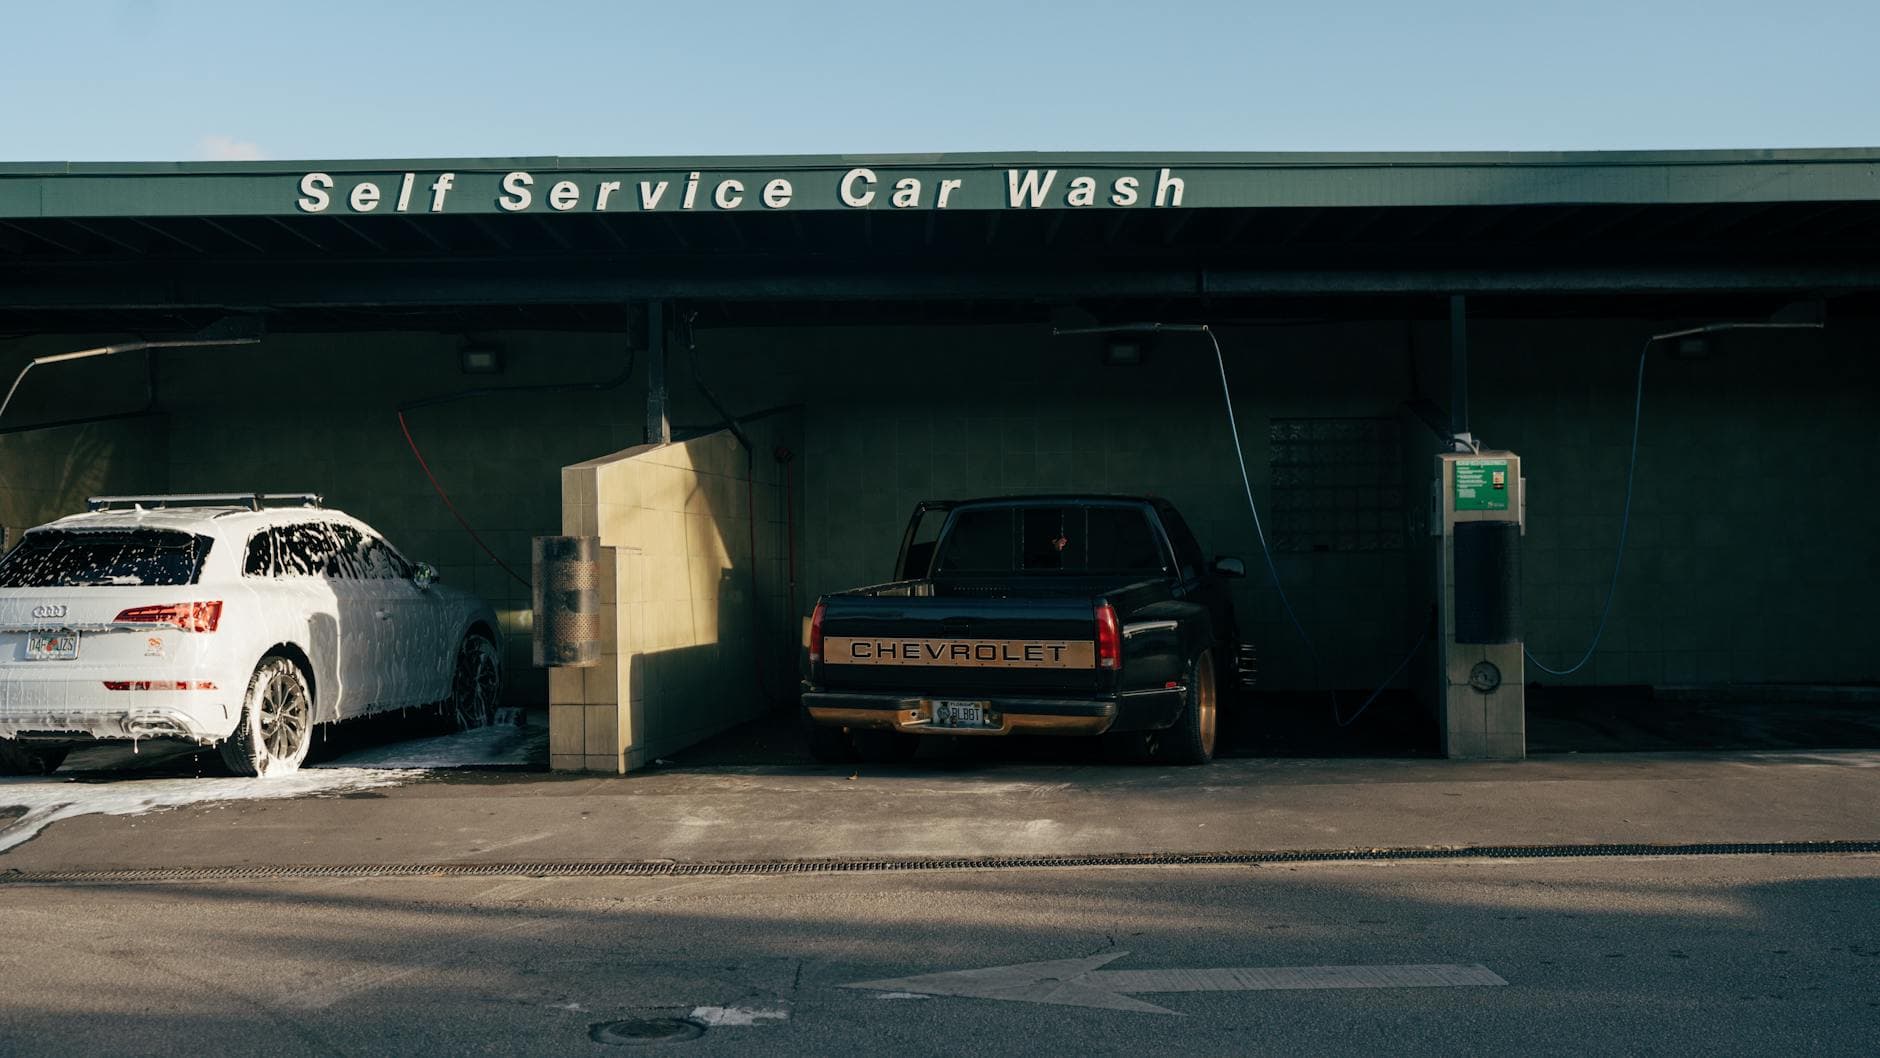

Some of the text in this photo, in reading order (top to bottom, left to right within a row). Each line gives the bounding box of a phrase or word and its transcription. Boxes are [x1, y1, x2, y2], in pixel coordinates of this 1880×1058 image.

[298, 167, 1186, 213] Self Service Car Wash
[850, 641, 1067, 662] CHEVROLET
